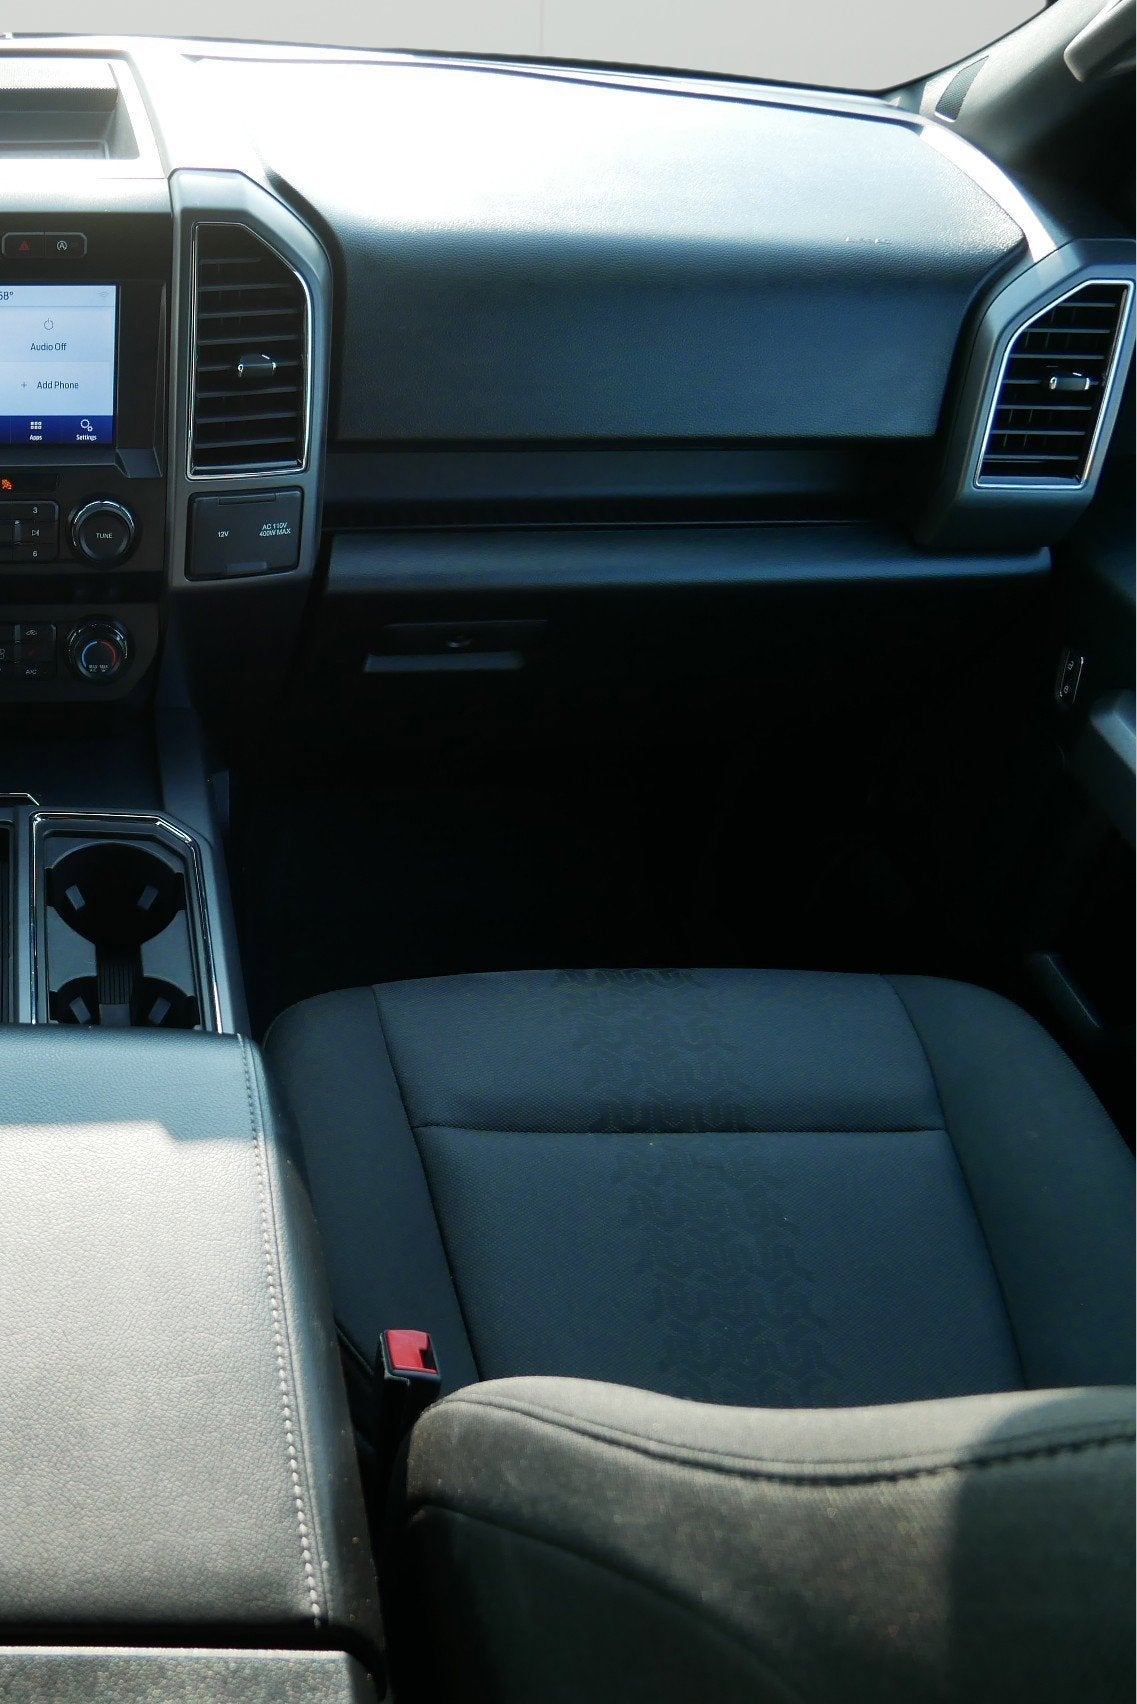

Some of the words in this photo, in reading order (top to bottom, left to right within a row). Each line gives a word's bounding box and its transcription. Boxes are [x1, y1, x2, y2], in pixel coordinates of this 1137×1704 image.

[30, 342, 54, 351] Audio
[54, 342, 68, 351] Off
[36, 381, 54, 389] Add
[55, 381, 79, 389] Phone
